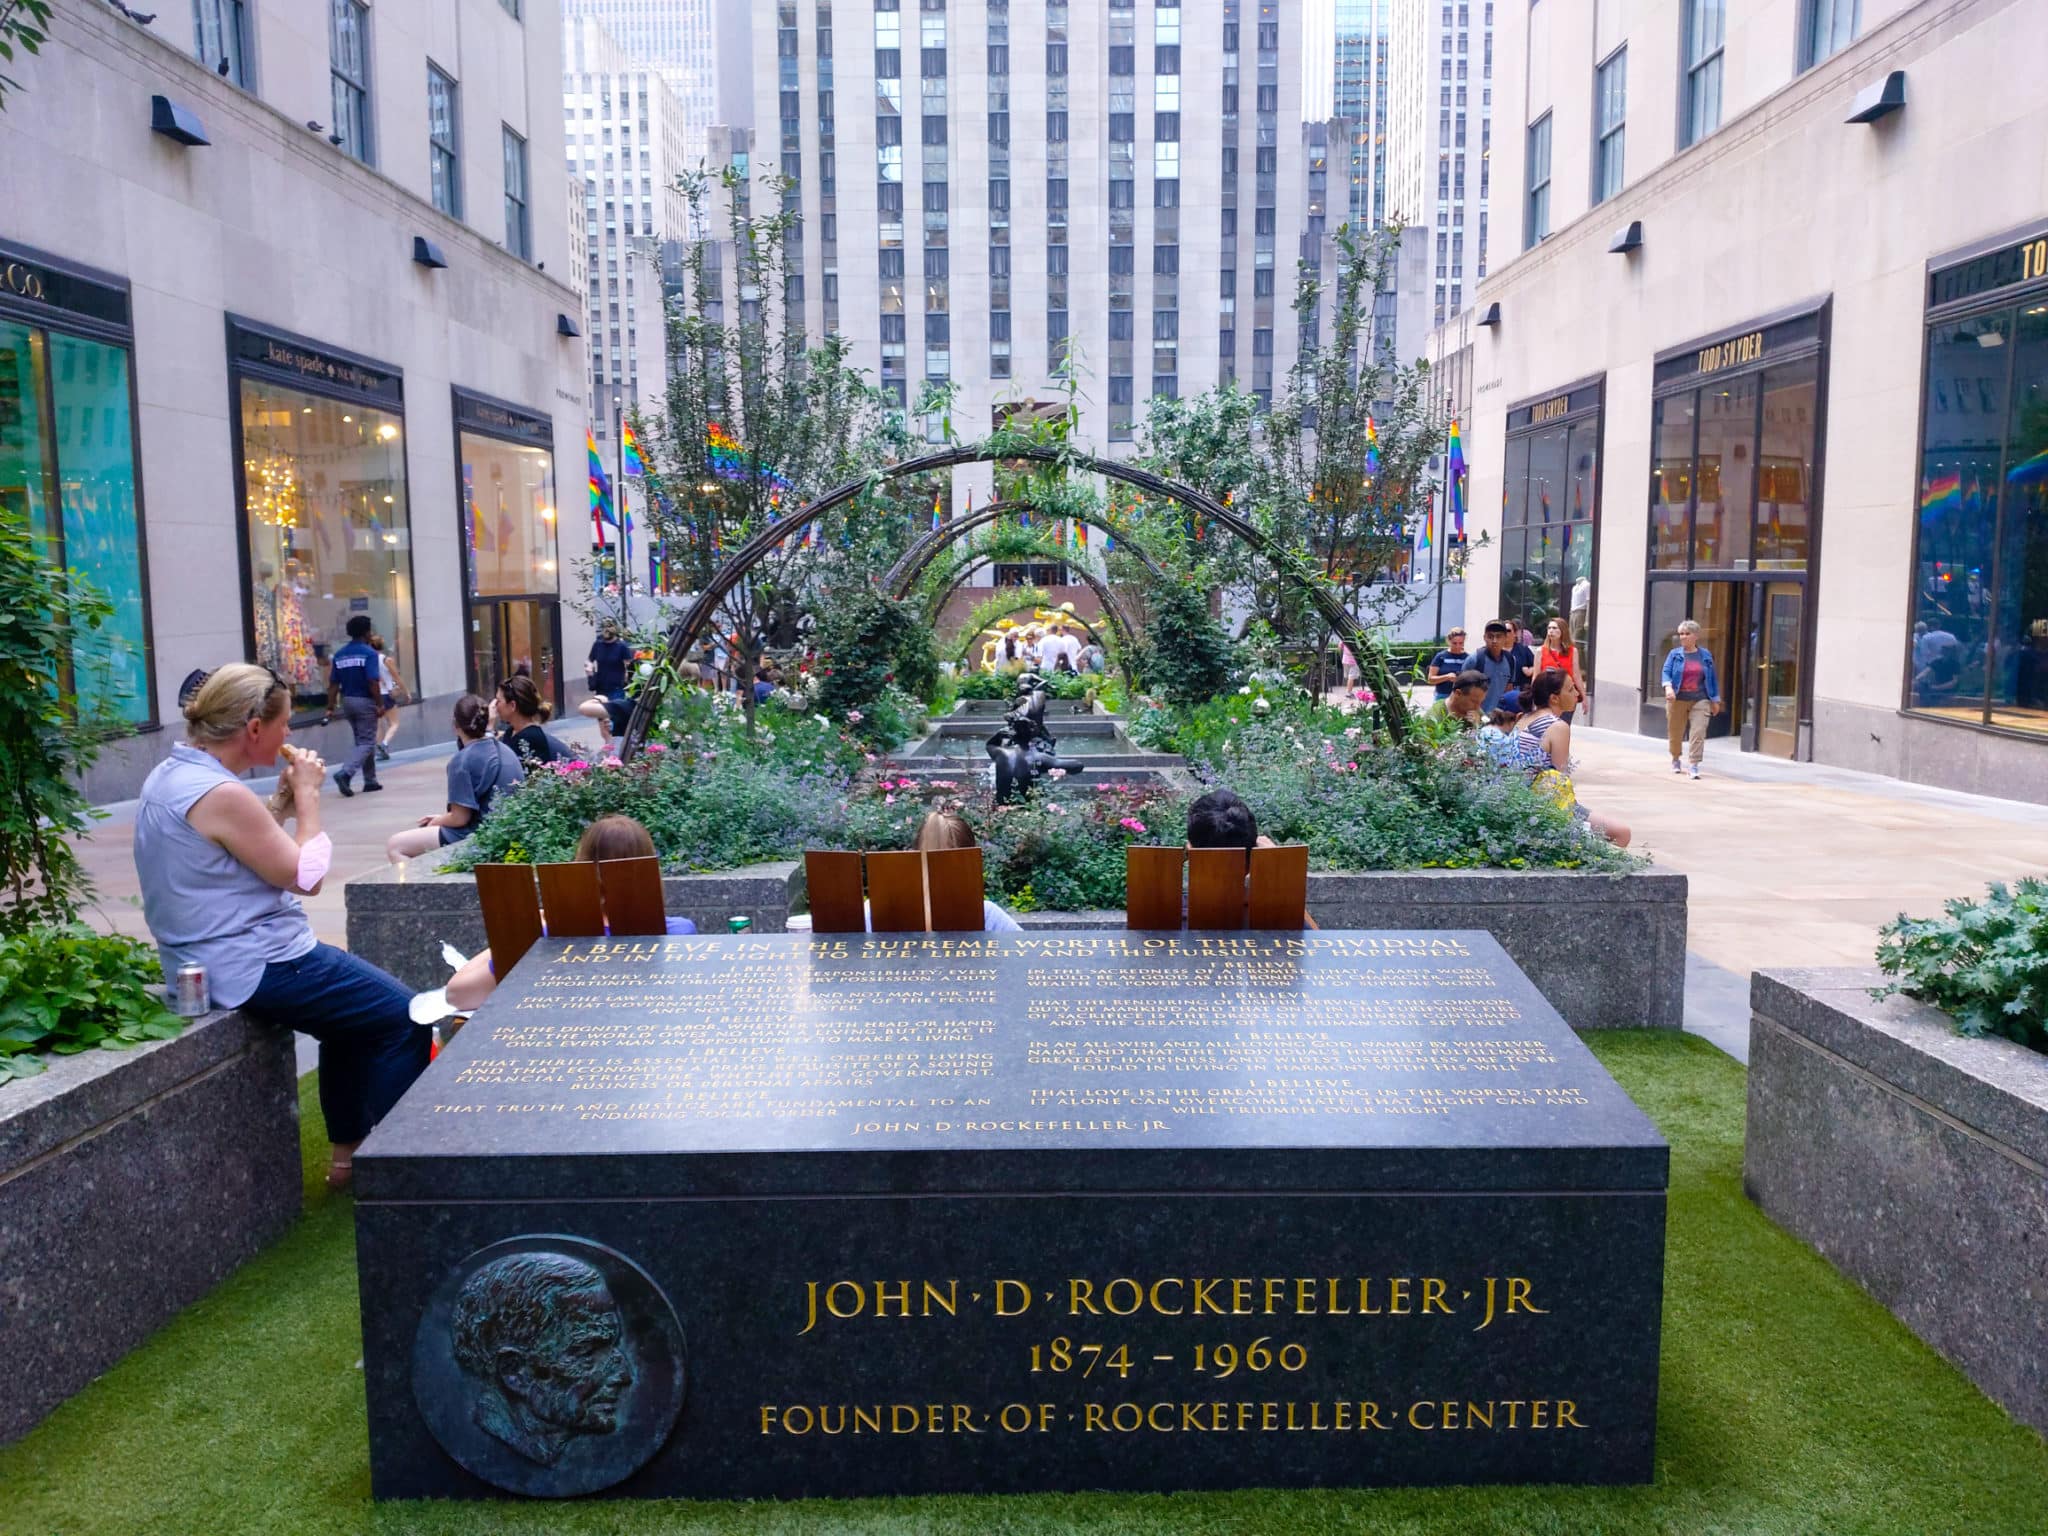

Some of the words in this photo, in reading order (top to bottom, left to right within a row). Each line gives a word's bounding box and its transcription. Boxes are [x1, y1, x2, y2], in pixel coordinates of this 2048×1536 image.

[2022, 240, 2048, 279] TO
[1698, 345, 1721, 374] TODD
[1722, 332, 1762, 368] SNYDER
[1532, 403, 1546, 425] TODD
[1546, 395, 1568, 419] SNYDER
[2031, 618, 2048, 637] ME
[587, 943, 724, 953] BELIEVE
[735, 942, 772, 951] IN
[785, 941, 849, 951] THE
[861, 940, 1001, 950] SUPREME
[1014, 939, 1127, 948] WORTH
[1142, 939, 1182, 947] OF
[1195, 938, 1258, 947] THE
[1272, 938, 1468, 947] INDIVIDUAL
[551, 954, 613, 963] AND
[622, 954, 654, 962] IN
[663, 953, 710, 961] HIS
[719, 952, 804, 960] RIGHT
[814, 951, 849, 959] TO
[930, 949, 1028, 958] LIBERTY
[1038, 949, 1094, 957] AND
[1167, 948, 1275, 956] PURSUIT
[1285, 948, 1321, 956] OF
[1330, 948, 1473, 956] HAPPINESS
[584, 1031, 653, 1039] WORLD
[814, 1028, 877, 1036] LIVING
[1249, 1032, 1330, 1040] BELIEVE
[503, 1040, 556, 1048] OWES
[558, 1039, 611, 1047] EVERY
[703, 1047, 787, 1055] BELIEVE
[510, 1066, 563, 1074] THAT
[566, 1065, 661, 1073] ECONOMY
[666, 1064, 684, 1072] IS
[927, 1060, 993, 1068] SOUND
[453, 1074, 568, 1083] FINANCIAL
[816, 1070, 840, 1078] IN
[1266, 1078, 1353, 1087] BELIEVE
[569, 1081, 659, 1089] BUSINESS
[698, 1079, 792, 1088] PERSONAL
[799, 1078, 874, 1087] AFFAIRS
[681, 1091, 771, 1100] BELIEVE
[1030, 1089, 1077, 1097] THAT
[1164, 1088, 1201, 1096] THE
[1207, 1088, 1297, 1096] GREATEST
[1305, 1088, 1370, 1096] THING
[1376, 1088, 1399, 1096] IN
[1405, 1088, 1446, 1096] THE
[430, 1104, 488, 1113] THAT
[572, 1102, 620, 1111] AND
[765, 1098, 920, 1108] FUNDAMENTAL
[929, 1098, 955, 1106] TO
[1130, 1097, 1171, 1105] CAN
[1178, 1097, 1288, 1105] OVERCOME
[579, 1110, 688, 1119] ENDURING
[771, 1108, 838, 1117] ORDER
[1171, 1106, 1220, 1114] WILL
[1225, 1106, 1317, 1114] TRIUMPH
[1323, 1106, 1377, 1114] OVER
[1381, 1105, 1451, 1114] MIGHT
[852, 1122, 920, 1135] JOHN
[934, 1121, 952, 1131] D
[965, 1120, 1133, 1131] ROCKEFELLER
[1141, 1119, 1171, 1133] JR
[1030, 1336, 1135, 1379] 1874
[1193, 1336, 1308, 1379] 1960
